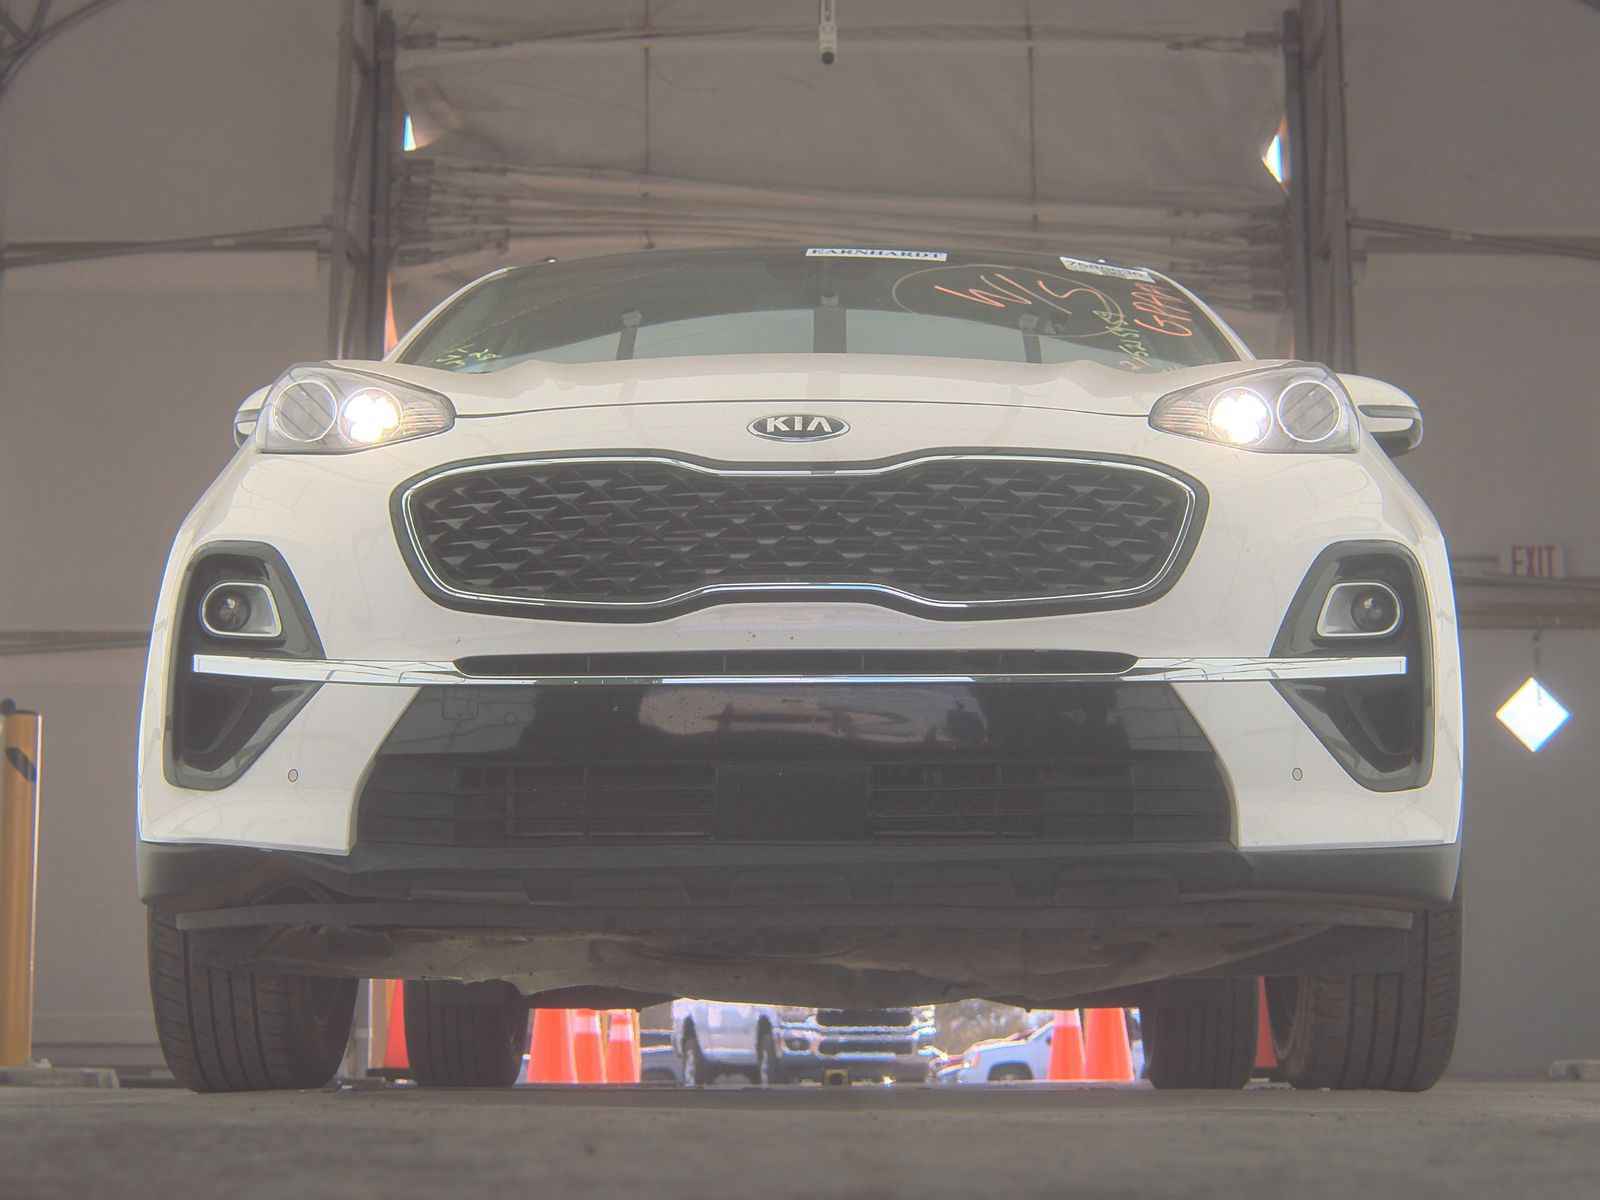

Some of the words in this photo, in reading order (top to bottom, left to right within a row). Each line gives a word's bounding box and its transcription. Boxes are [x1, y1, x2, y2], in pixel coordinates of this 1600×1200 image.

[810, 248, 941, 259] EARNHARDT
[766, 416, 832, 433] KIA
[1510, 545, 1556, 577] EXIT
